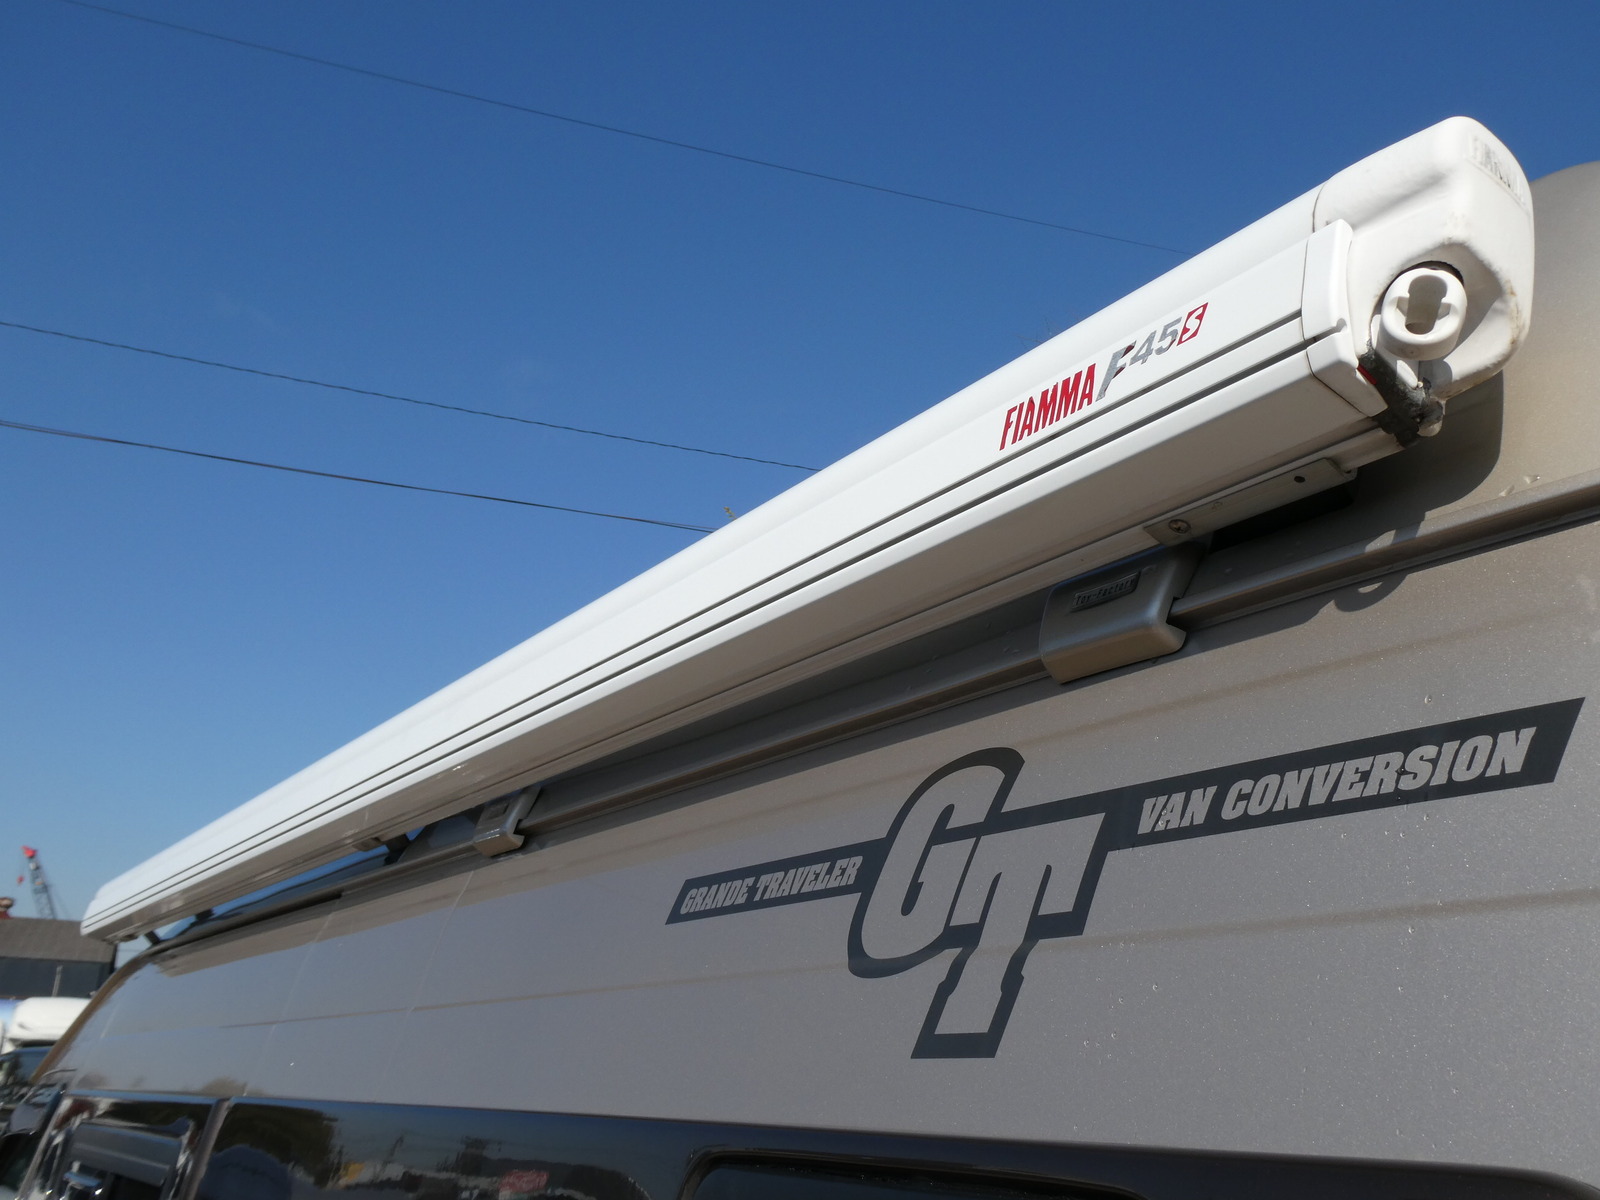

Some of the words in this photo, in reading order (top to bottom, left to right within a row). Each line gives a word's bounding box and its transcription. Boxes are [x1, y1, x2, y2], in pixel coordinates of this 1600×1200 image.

[1000, 363, 1096, 451] FIAMMA
[1137, 785, 1218, 835] VAN
[1220, 726, 1538, 821] CONVERSION
[680, 876, 756, 915] GRANDE
[753, 855, 864, 902] TRAVELER
[847, 747, 1108, 1060] GT
